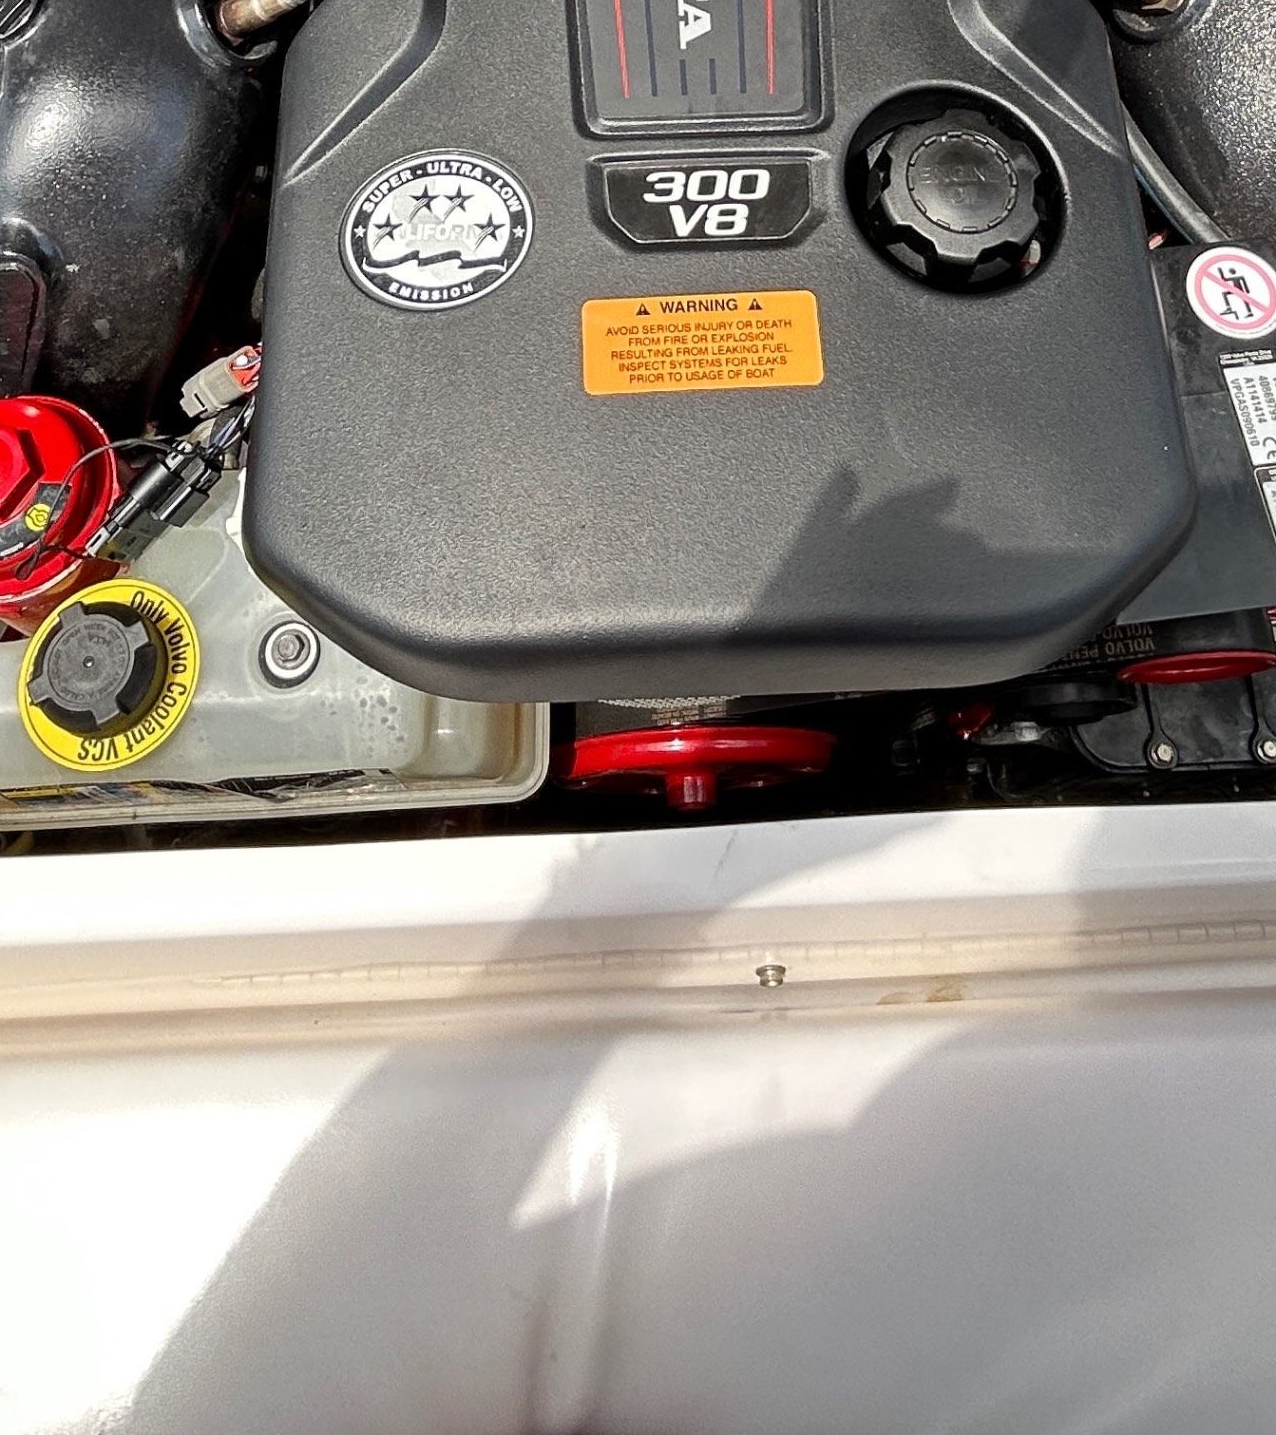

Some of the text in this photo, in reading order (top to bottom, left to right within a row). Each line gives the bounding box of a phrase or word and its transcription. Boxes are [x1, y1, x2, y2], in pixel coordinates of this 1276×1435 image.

[362, 161, 523, 213] SUPER ULTRA LOW
[642, 168, 771, 203] 300
[668, 203, 749, 237] V8
[388, 281, 474, 301] EMISSION
[659, 298, 738, 314] WARNING
[606, 319, 792, 337] AVOID SERIOUS INJURY OR DEATH
[628, 332, 774, 347] FROM FIRE OR EXPLOSION
[611, 348, 673, 360] RESULTING
[676, 347, 709, 358] FROM
[712, 344, 759, 355] LEAKING
[619, 355, 787, 372] INSPECT SYSTEMS FOR LEAKS
[629, 367, 775, 384] PRIOR TO USAGE OF BOAT
[1243, 376, 1267, 424] A1141414
[130, 590, 169, 625] Only
[164, 618, 191, 674] Volvo
[1105, 638, 1155, 655] VOLVO
[123, 682, 188, 753] Coolant
[78, 736, 119, 761] VCS
